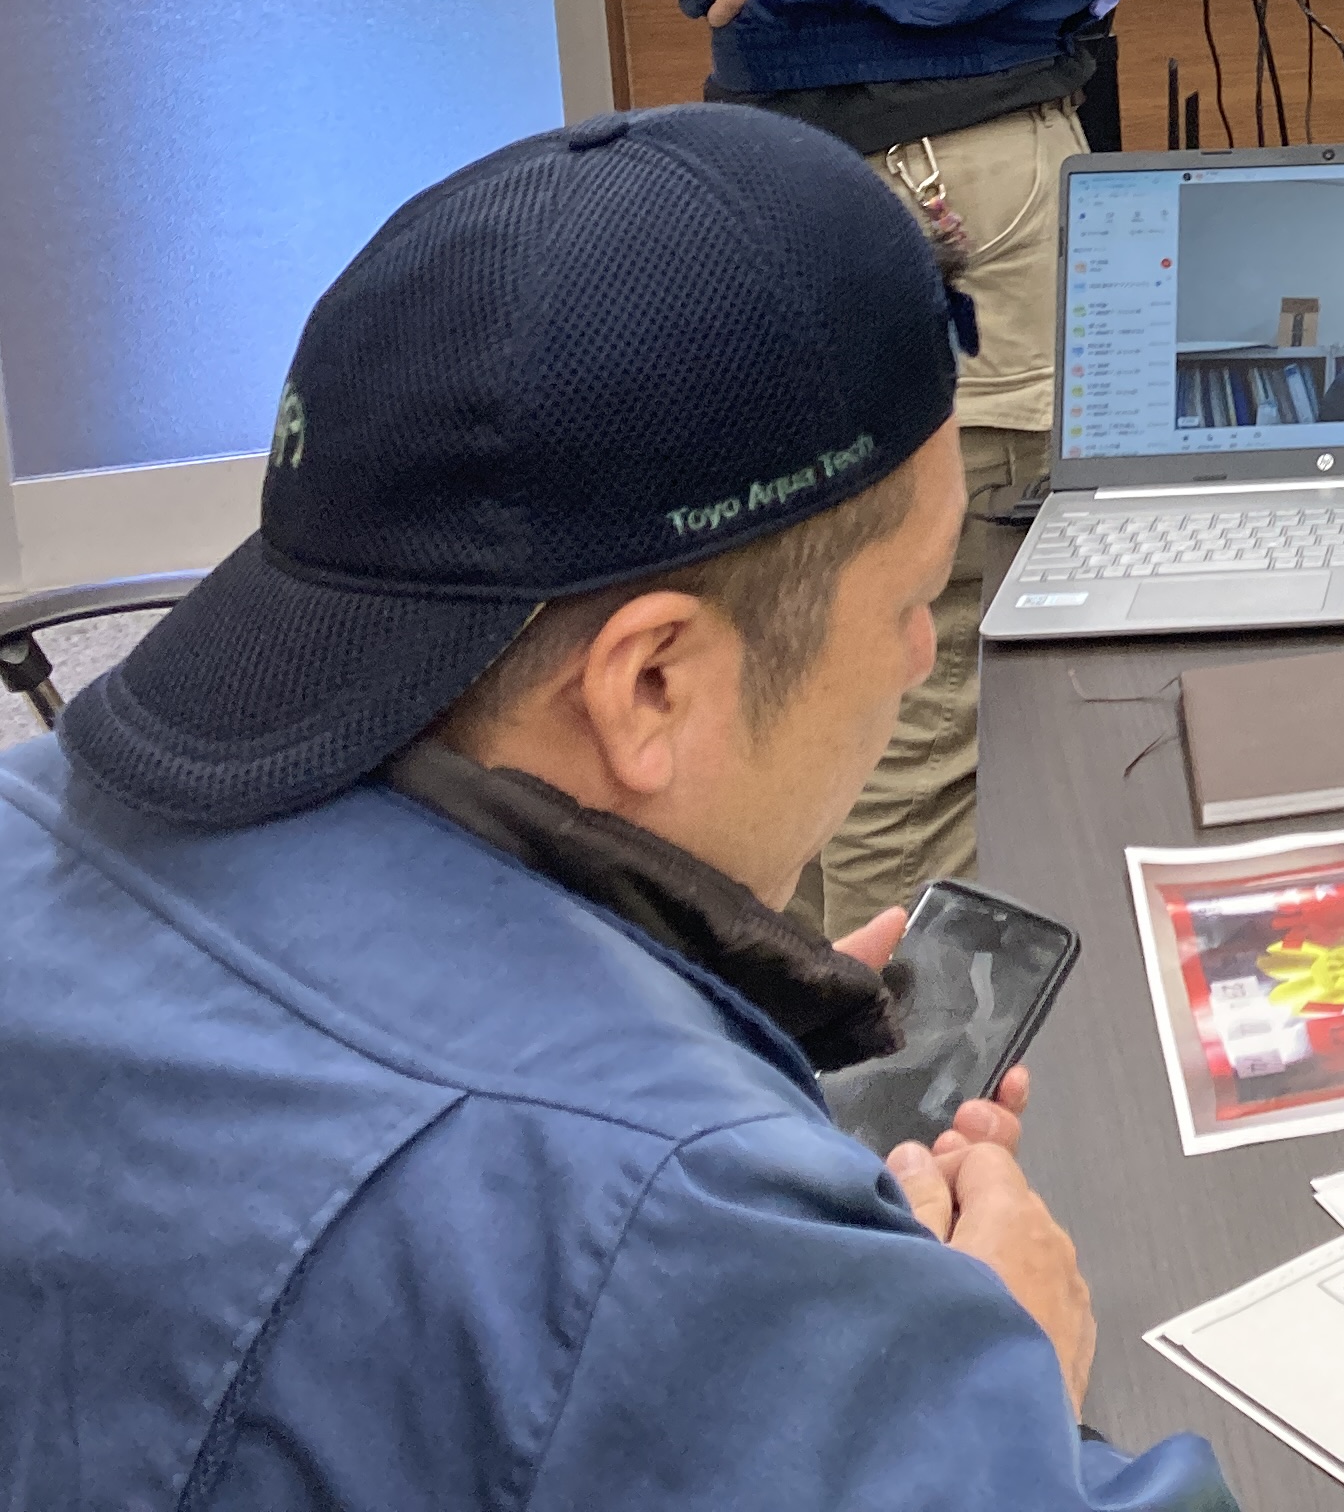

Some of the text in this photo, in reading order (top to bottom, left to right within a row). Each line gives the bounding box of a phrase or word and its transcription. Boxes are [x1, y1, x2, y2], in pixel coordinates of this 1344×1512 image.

[667, 433, 875, 536] Toyo Aqua Tech
